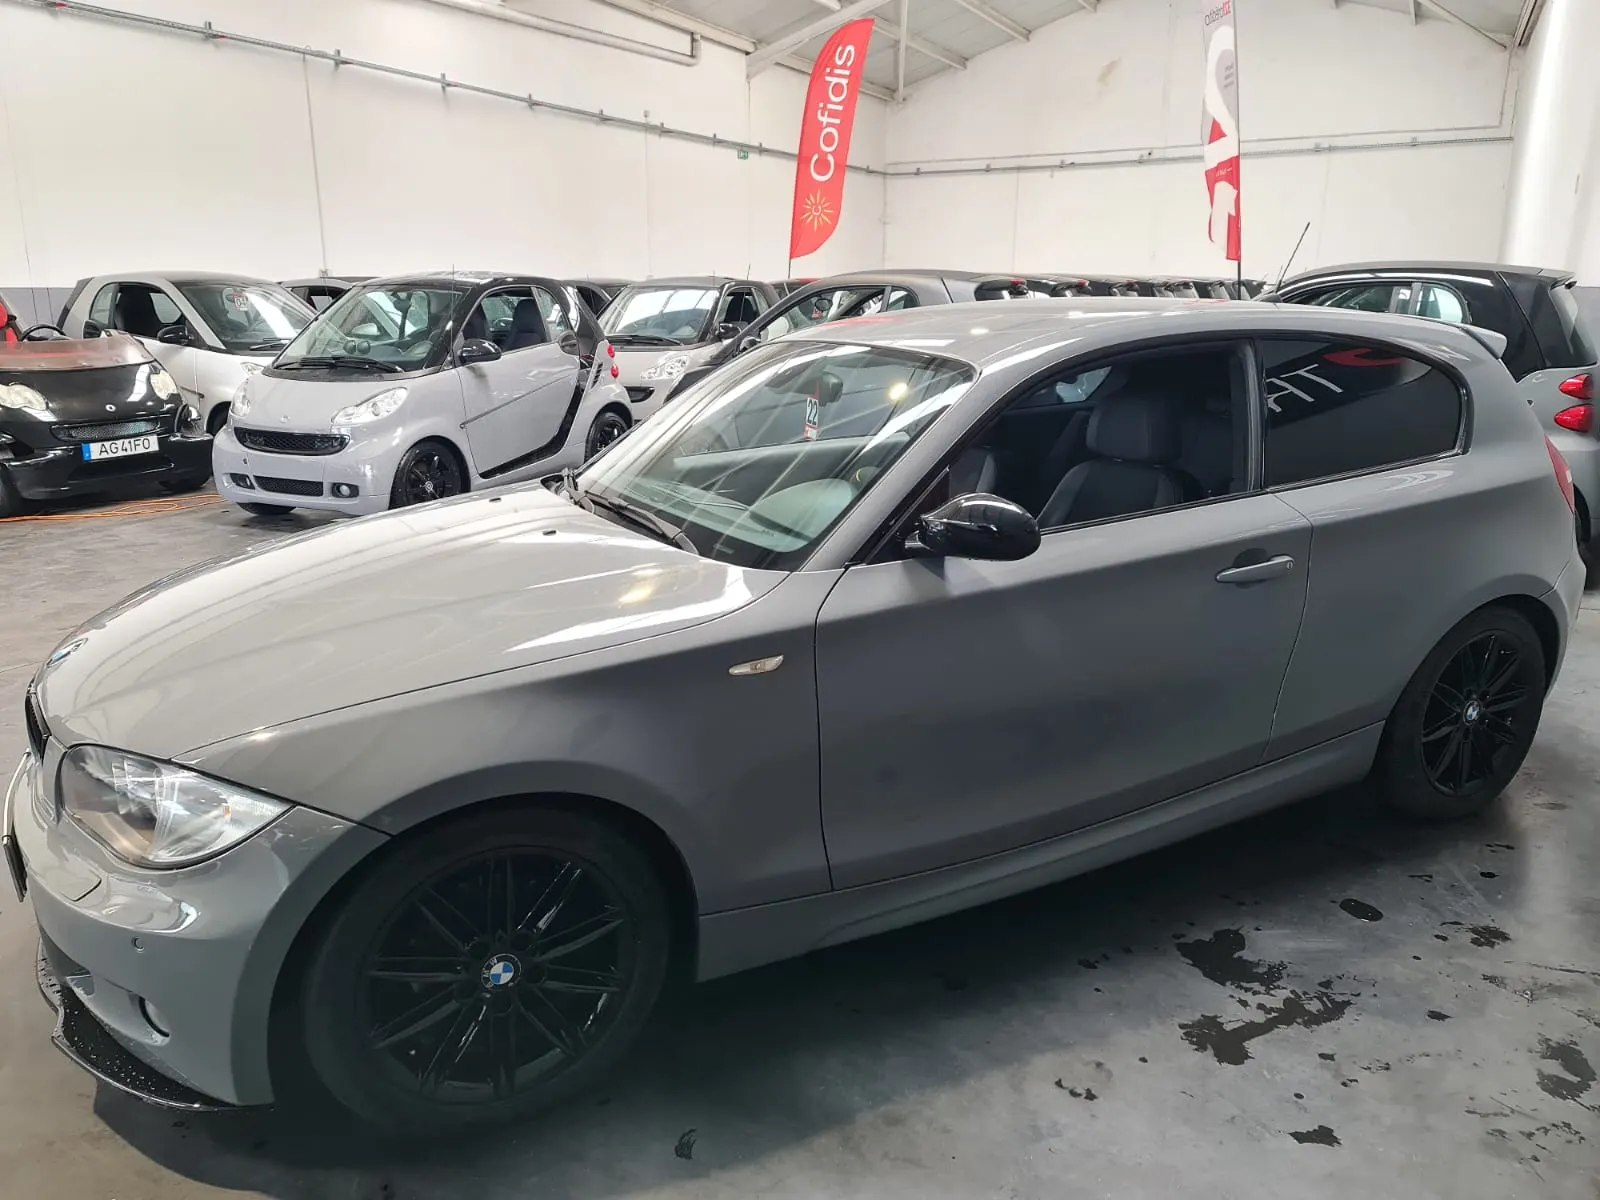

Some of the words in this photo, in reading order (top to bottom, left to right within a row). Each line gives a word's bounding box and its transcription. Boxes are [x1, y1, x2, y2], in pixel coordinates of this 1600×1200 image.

[810, 44, 855, 182] Cofidis
[807, 399, 818, 426] 22
[99, 438, 151, 456] AG41FO
